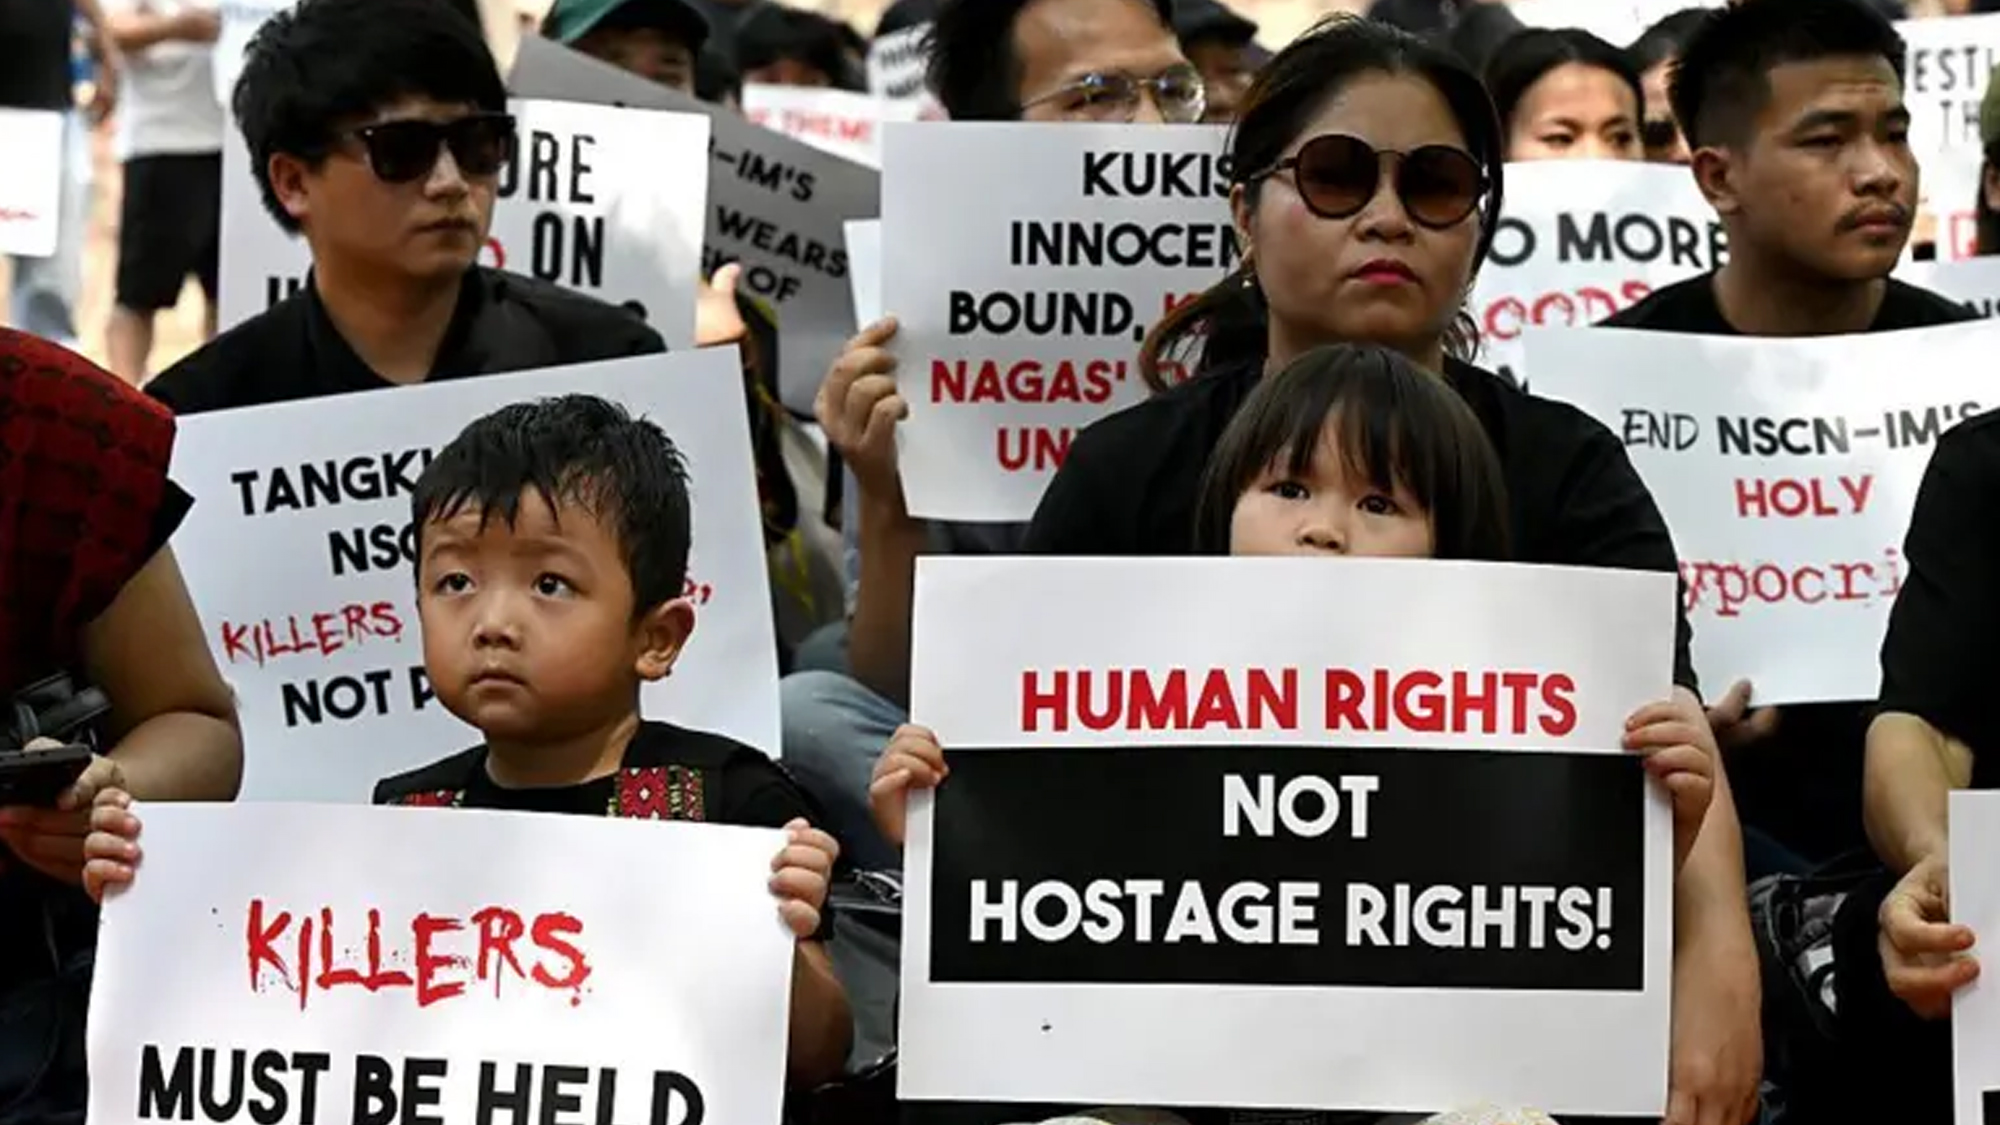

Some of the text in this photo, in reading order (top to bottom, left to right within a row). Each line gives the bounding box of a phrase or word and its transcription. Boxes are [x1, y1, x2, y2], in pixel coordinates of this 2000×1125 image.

[708, 135, 816, 203] -IM'S
[1083, 151, 1233, 198] KUKIS
[532, 211, 604, 287] ON
[716, 204, 847, 279] WEARS
[949, 291, 1144, 341] BOUND,
[931, 360, 1126, 403] NAGAS'
[997, 427, 1084, 471] UN
[1621, 409, 1699, 450] END
[1735, 475, 1873, 518] HOLY
[1678, 548, 1899, 617] ypocri
[222, 602, 403, 667] KILLERS
[281, 669, 392, 727] NOT
[1021, 668, 1577, 737] HUMAN RIGHTS
[1223, 774, 1379, 838] NOT
[969, 880, 1612, 950] HOSTAGE RIGHTS!
[247, 899, 591, 1008] KILLERS
[138, 1044, 705, 1125] MUST BE HELD
